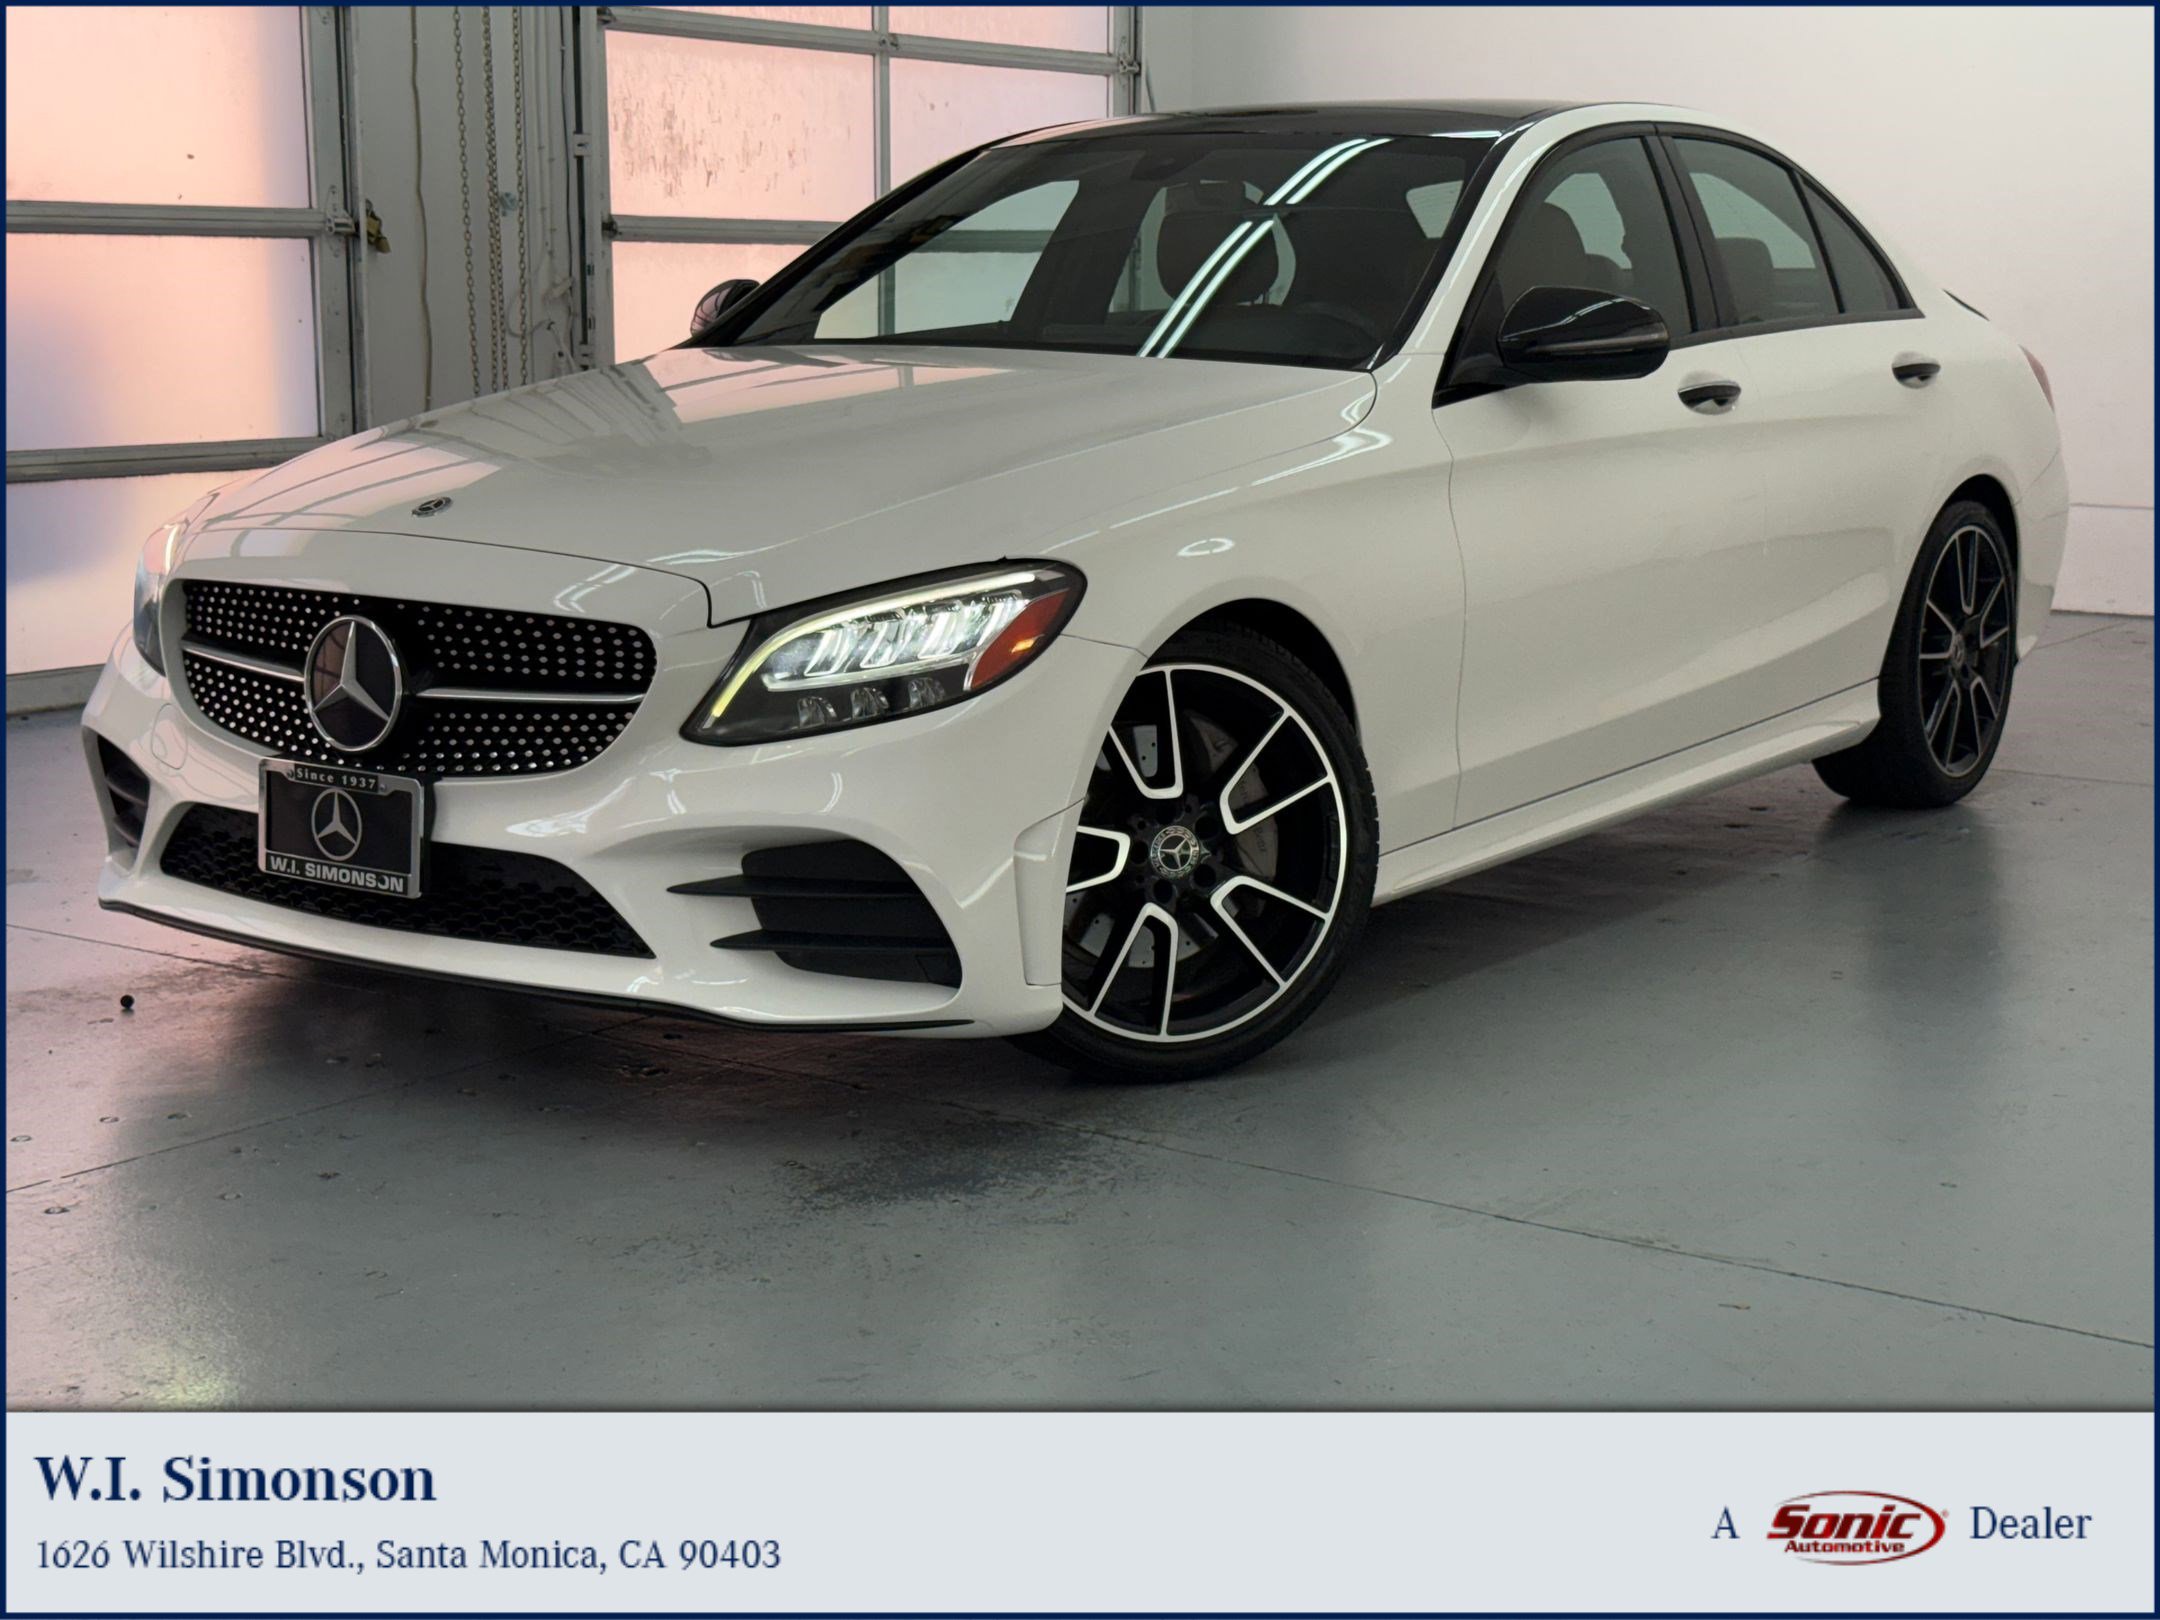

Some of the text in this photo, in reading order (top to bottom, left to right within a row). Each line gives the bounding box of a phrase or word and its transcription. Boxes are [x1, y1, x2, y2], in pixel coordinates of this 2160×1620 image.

[296, 768, 376, 789] Since 1937
[270, 855, 404, 893] W.I. SIMONSON
